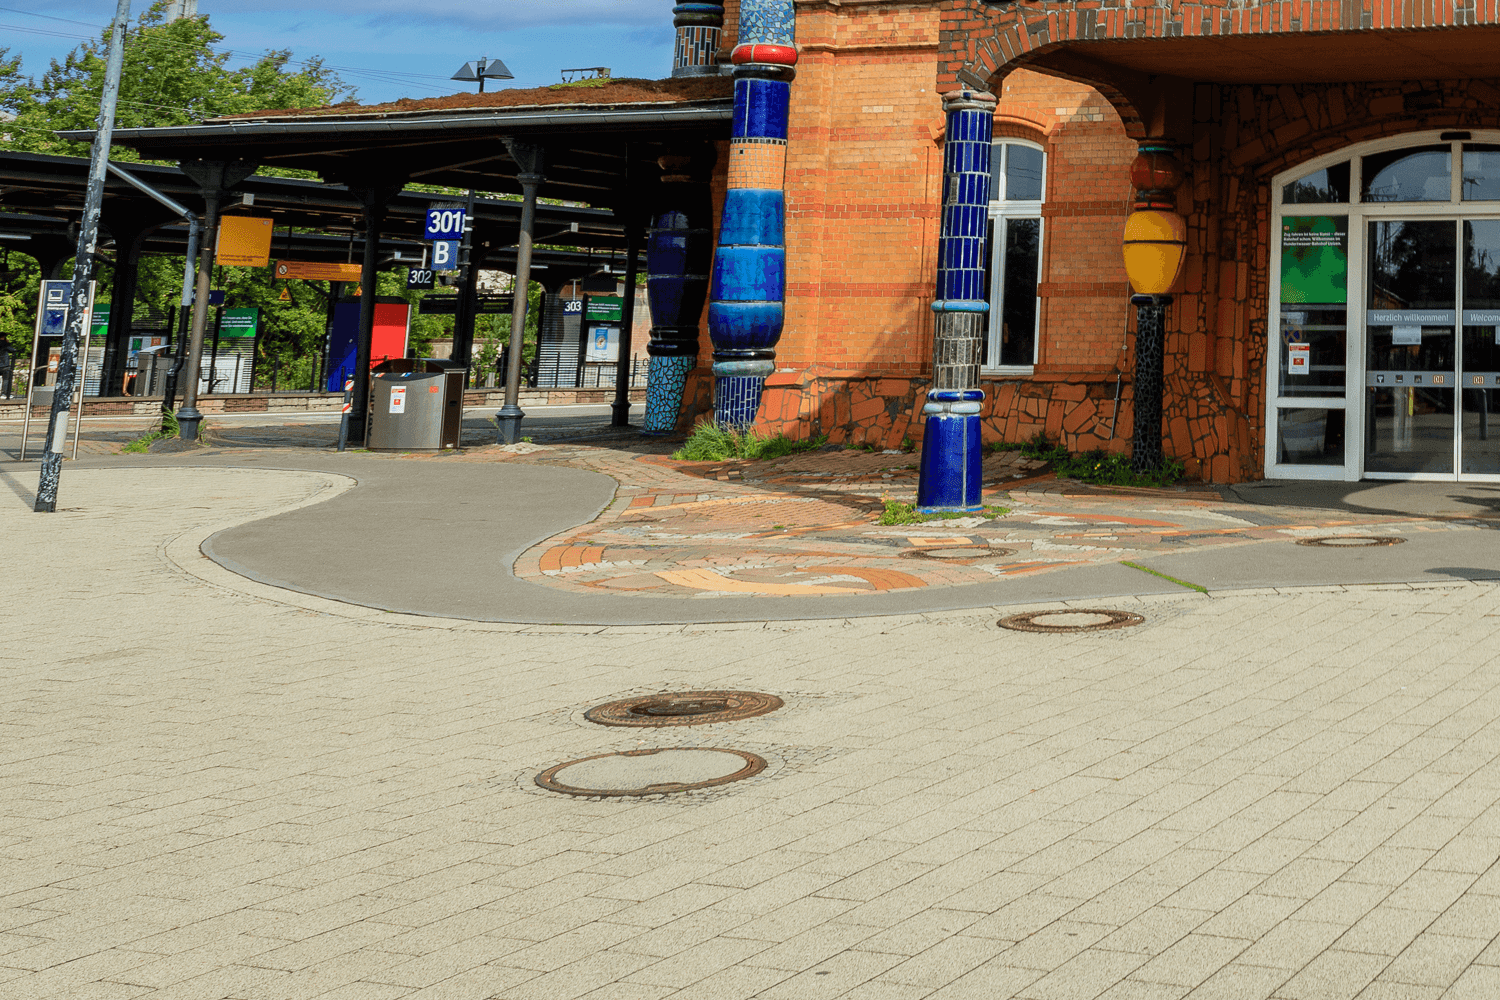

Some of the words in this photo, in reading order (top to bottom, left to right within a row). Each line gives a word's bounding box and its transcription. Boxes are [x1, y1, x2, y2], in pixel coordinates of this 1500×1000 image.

[427, 210, 462, 234] 301
[434, 241, 450, 265] B
[409, 270, 432, 284] 302
[564, 301, 581, 312] 303
[1373, 313, 1402, 322] Herzlich
[1404, 313, 1449, 322] willkommen!
